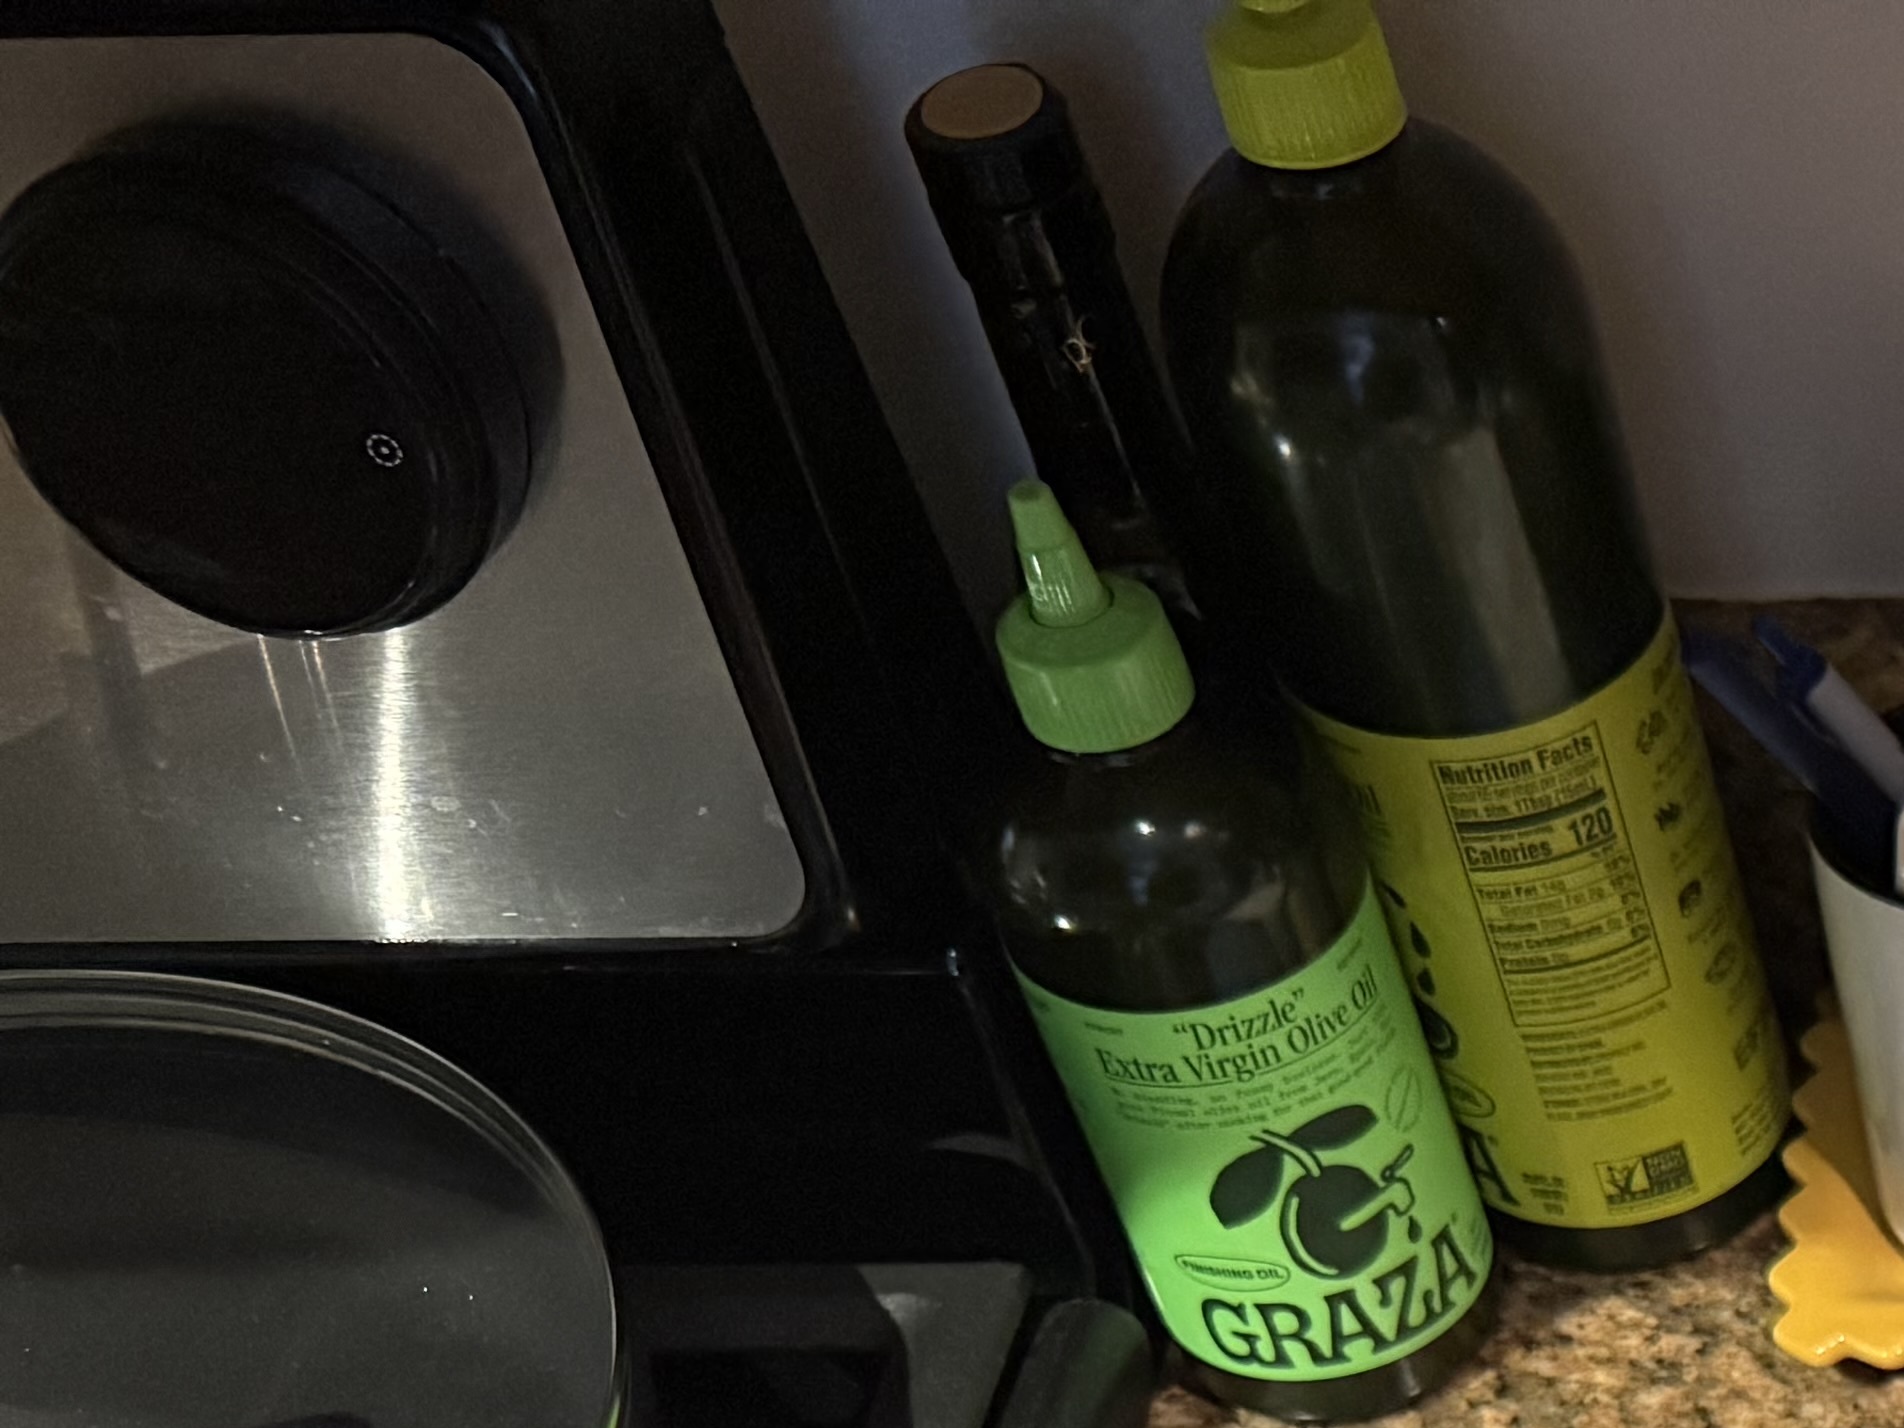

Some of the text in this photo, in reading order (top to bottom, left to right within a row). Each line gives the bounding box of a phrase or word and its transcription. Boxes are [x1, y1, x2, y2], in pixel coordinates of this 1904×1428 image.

[1438, 734, 1593, 786] Nutrition Facts
[1464, 807, 1615, 868] Calories 120
[1095, 967, 1378, 1085] Extra Virgin Olive Oil
[1201, 1224, 1478, 1369] GRAZA
[1256, 1268, 1285, 1280] OIL
